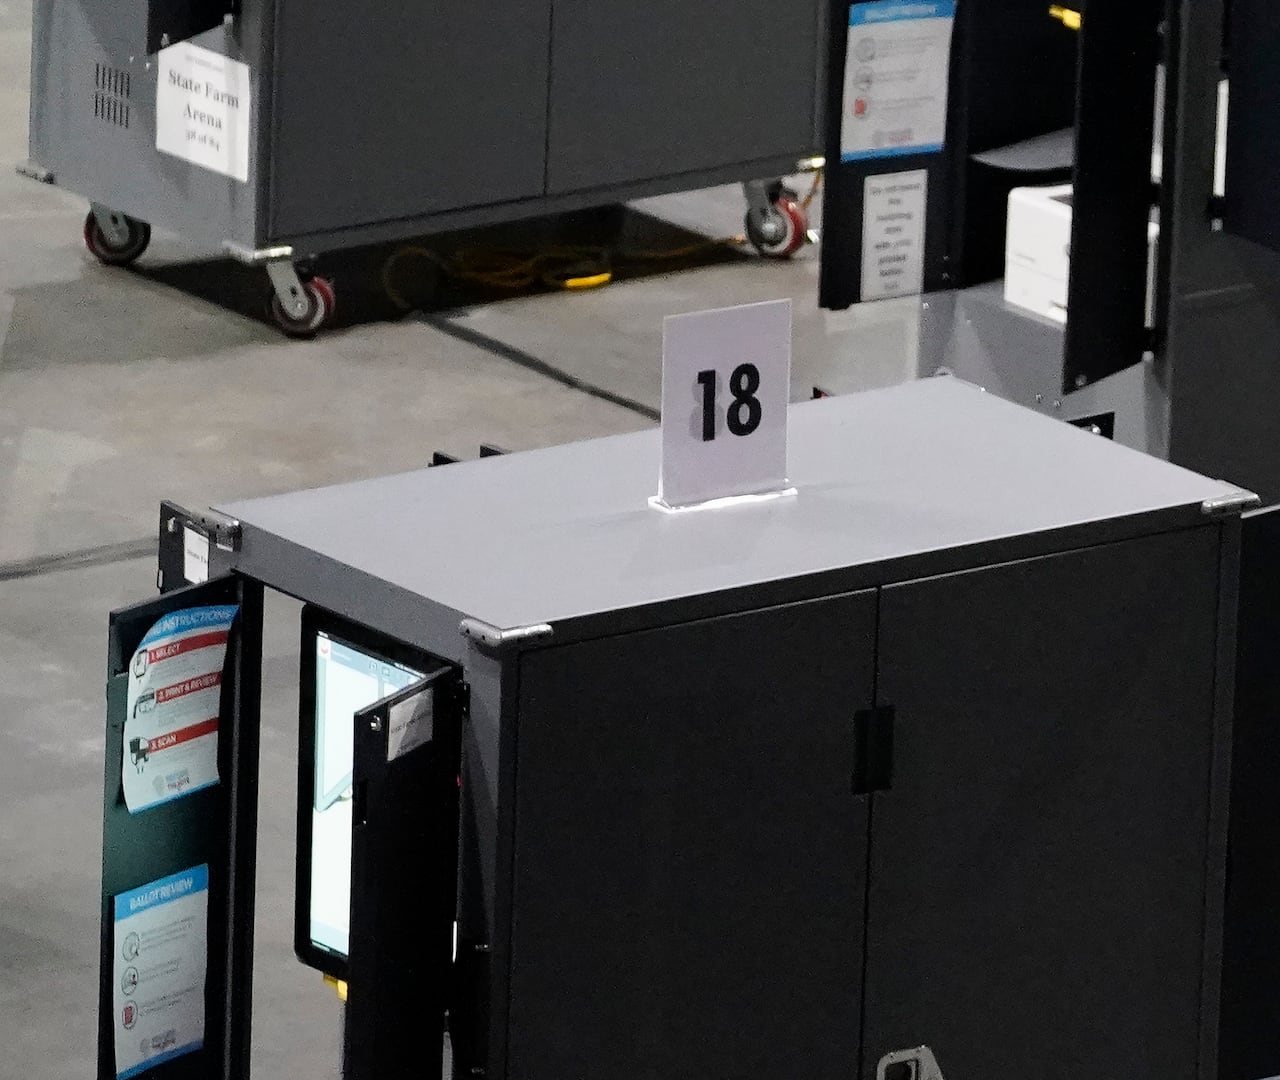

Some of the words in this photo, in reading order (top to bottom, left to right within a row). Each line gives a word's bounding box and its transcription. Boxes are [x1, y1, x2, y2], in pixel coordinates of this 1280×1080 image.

[168, 69, 201, 93] State
[205, 81, 239, 109] Farm
[184, 103, 222, 129] Arena
[697, 363, 762, 441] 18
